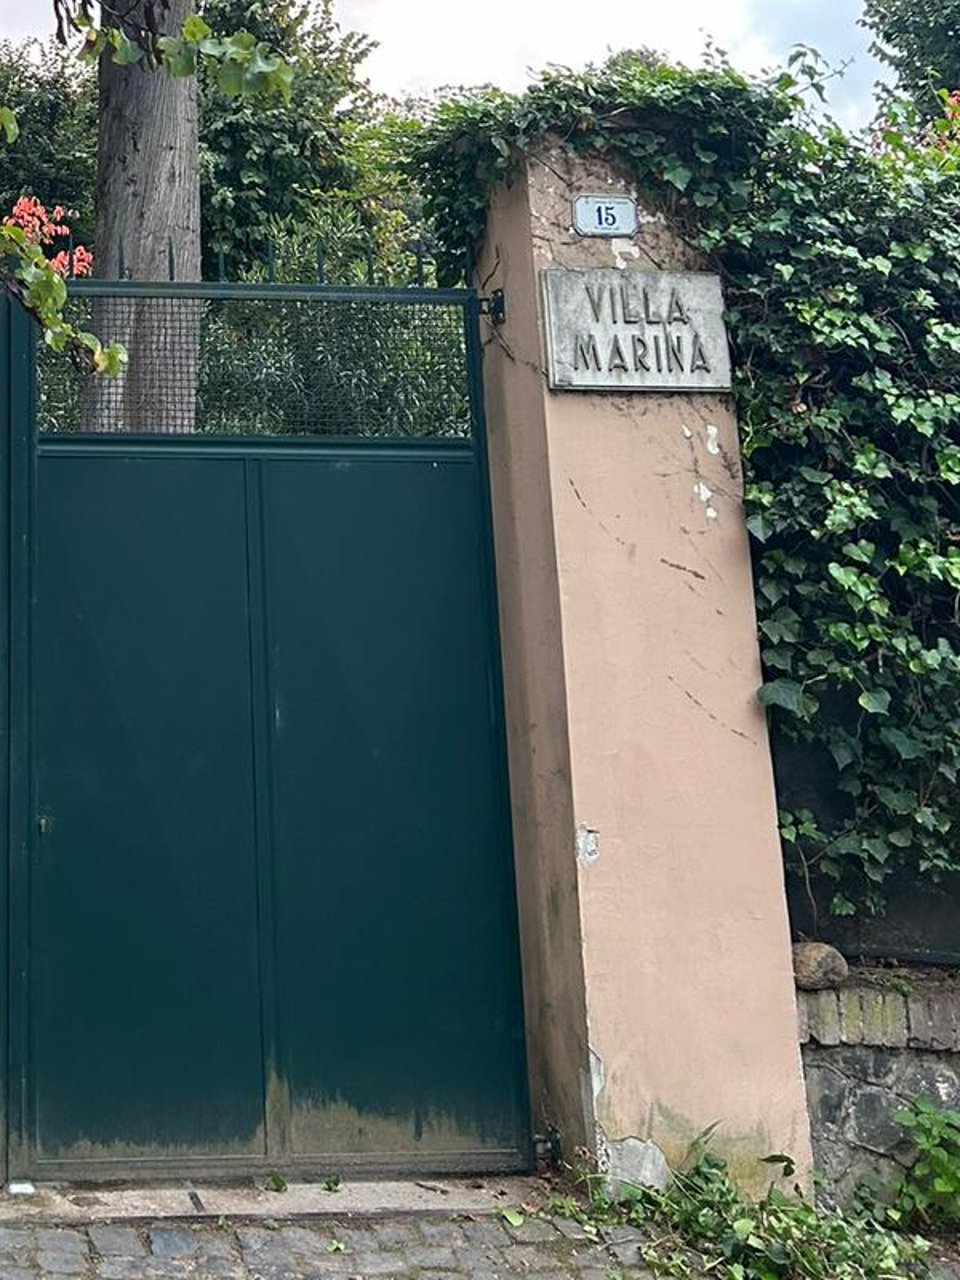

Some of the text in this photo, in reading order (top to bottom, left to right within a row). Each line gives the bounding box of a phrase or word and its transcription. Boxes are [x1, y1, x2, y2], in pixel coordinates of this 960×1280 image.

[596, 206, 617, 227] 15
[585, 285, 689, 325] VILLA
[573, 333, 711, 373] MARINA
